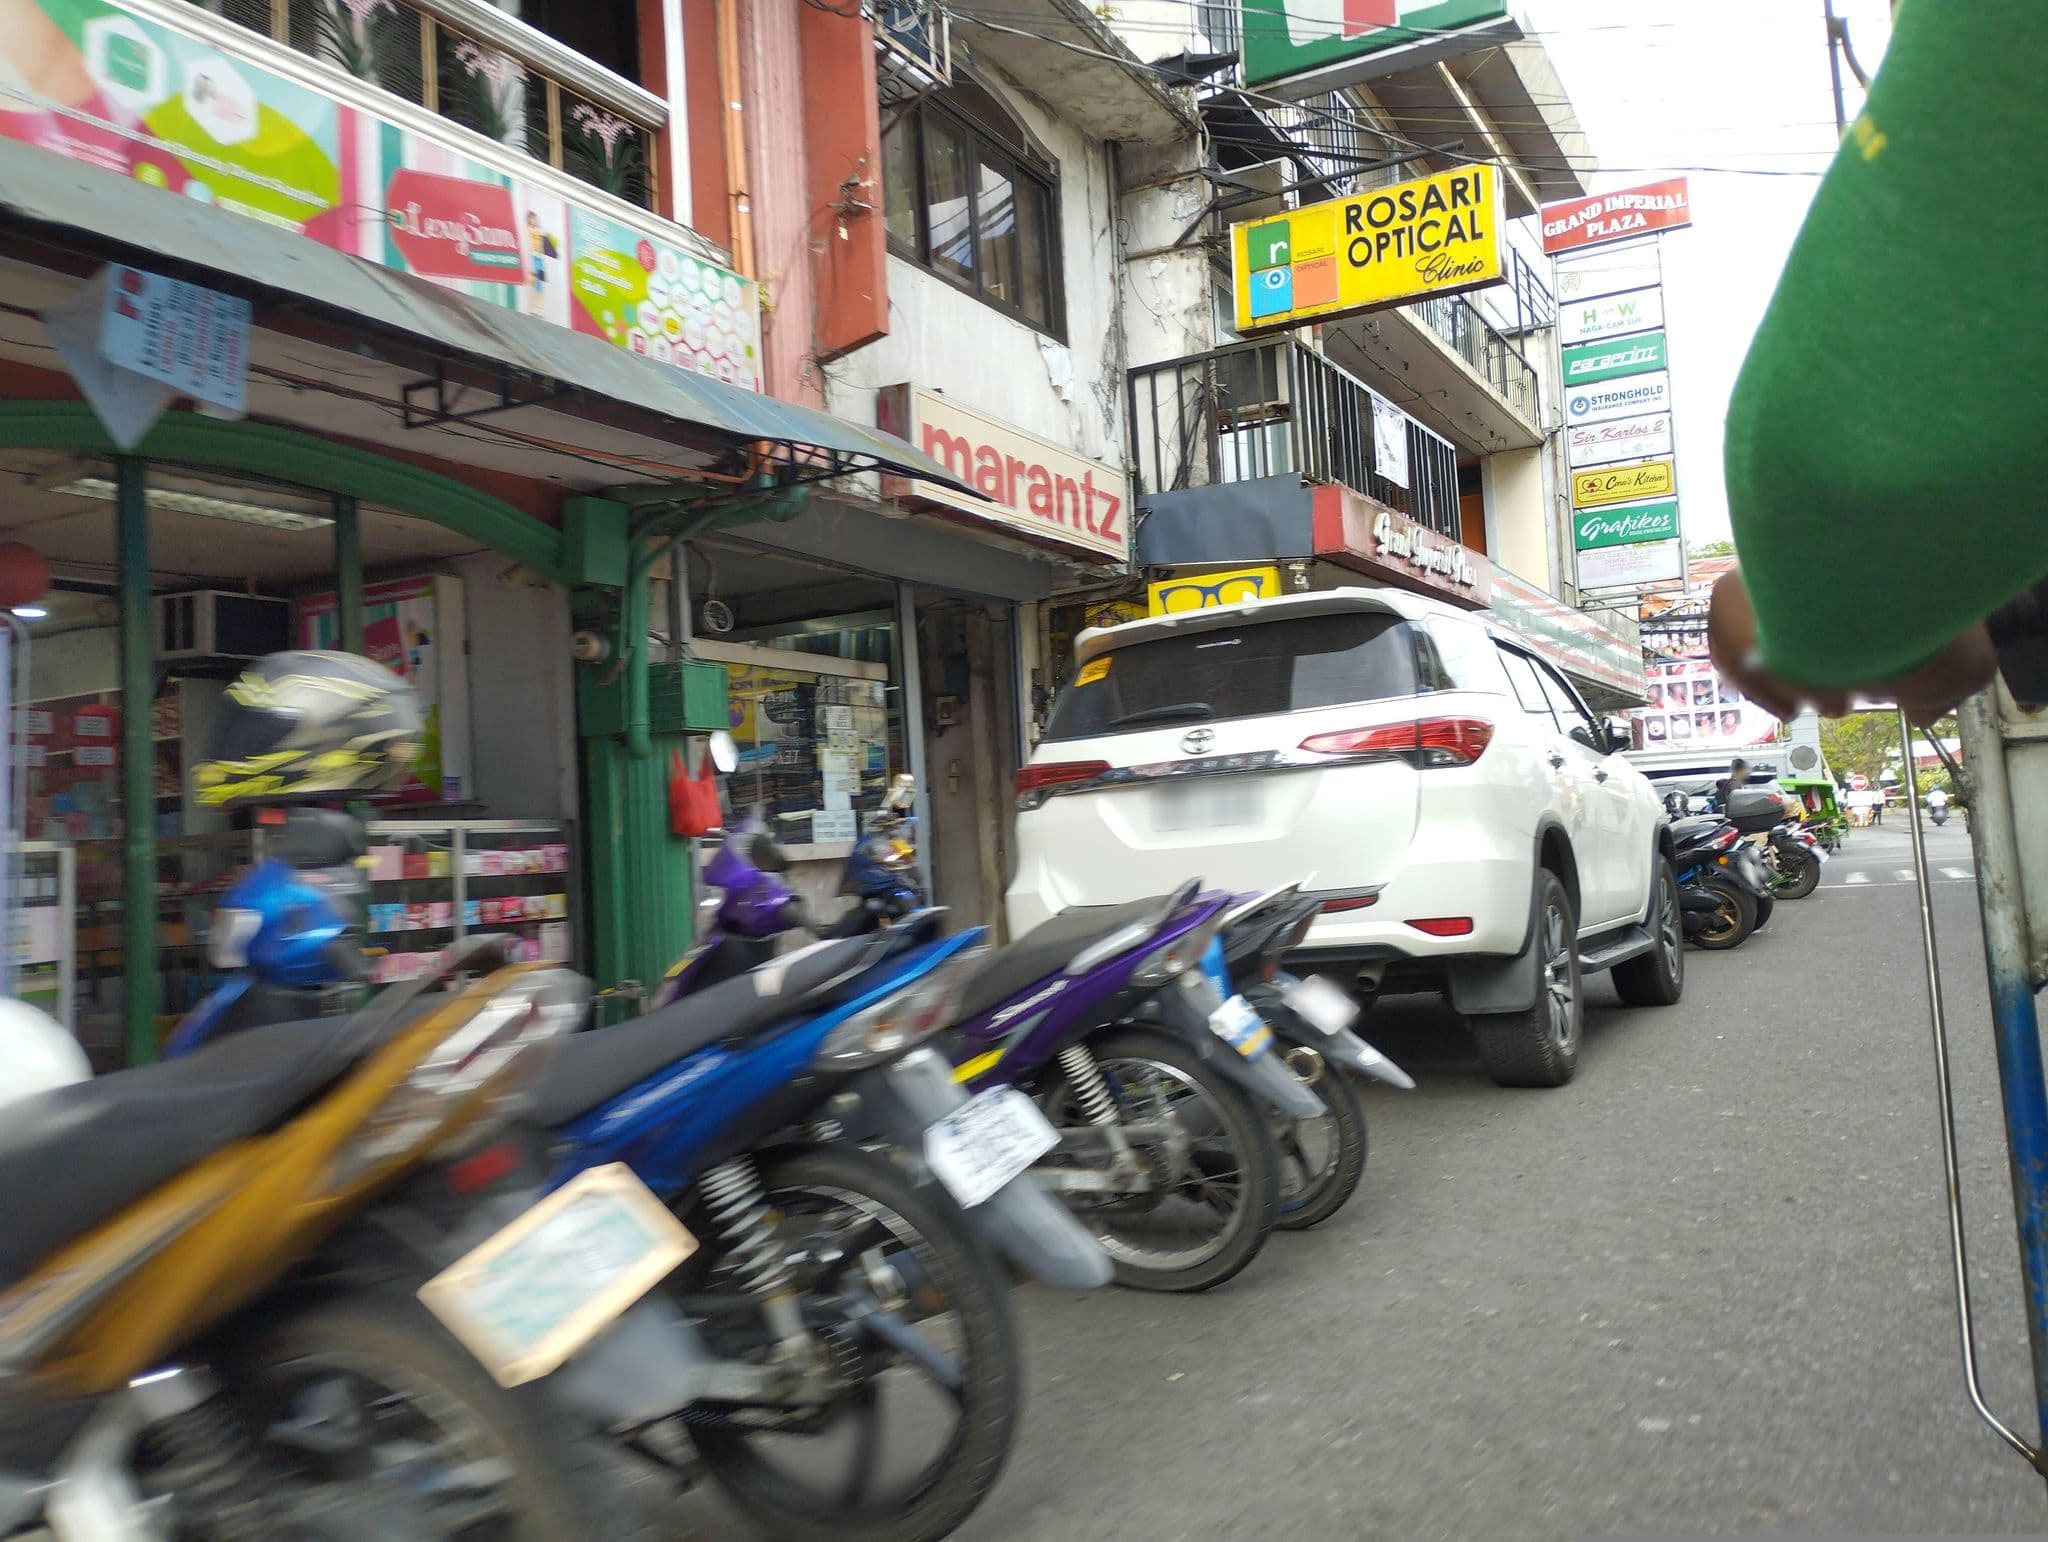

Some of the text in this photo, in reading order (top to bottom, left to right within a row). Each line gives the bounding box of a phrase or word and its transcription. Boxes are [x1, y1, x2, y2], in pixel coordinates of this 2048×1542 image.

[1345, 172, 1481, 235] ROSARI
[1544, 193, 1688, 237] GRAND IMPERIAL
[1348, 210, 1483, 267] OPTICAL
[1586, 212, 1648, 238] PLAZA
[1296, 260, 1328, 272] OPTICAL
[1415, 252, 1484, 284] Clinic
[1591, 385, 1664, 405] STRONGHOLD
[1572, 419, 1665, 446] Sir Karlos 2
[922, 421, 1122, 543] marantz
[1634, 472, 1665, 486] Kitchen
